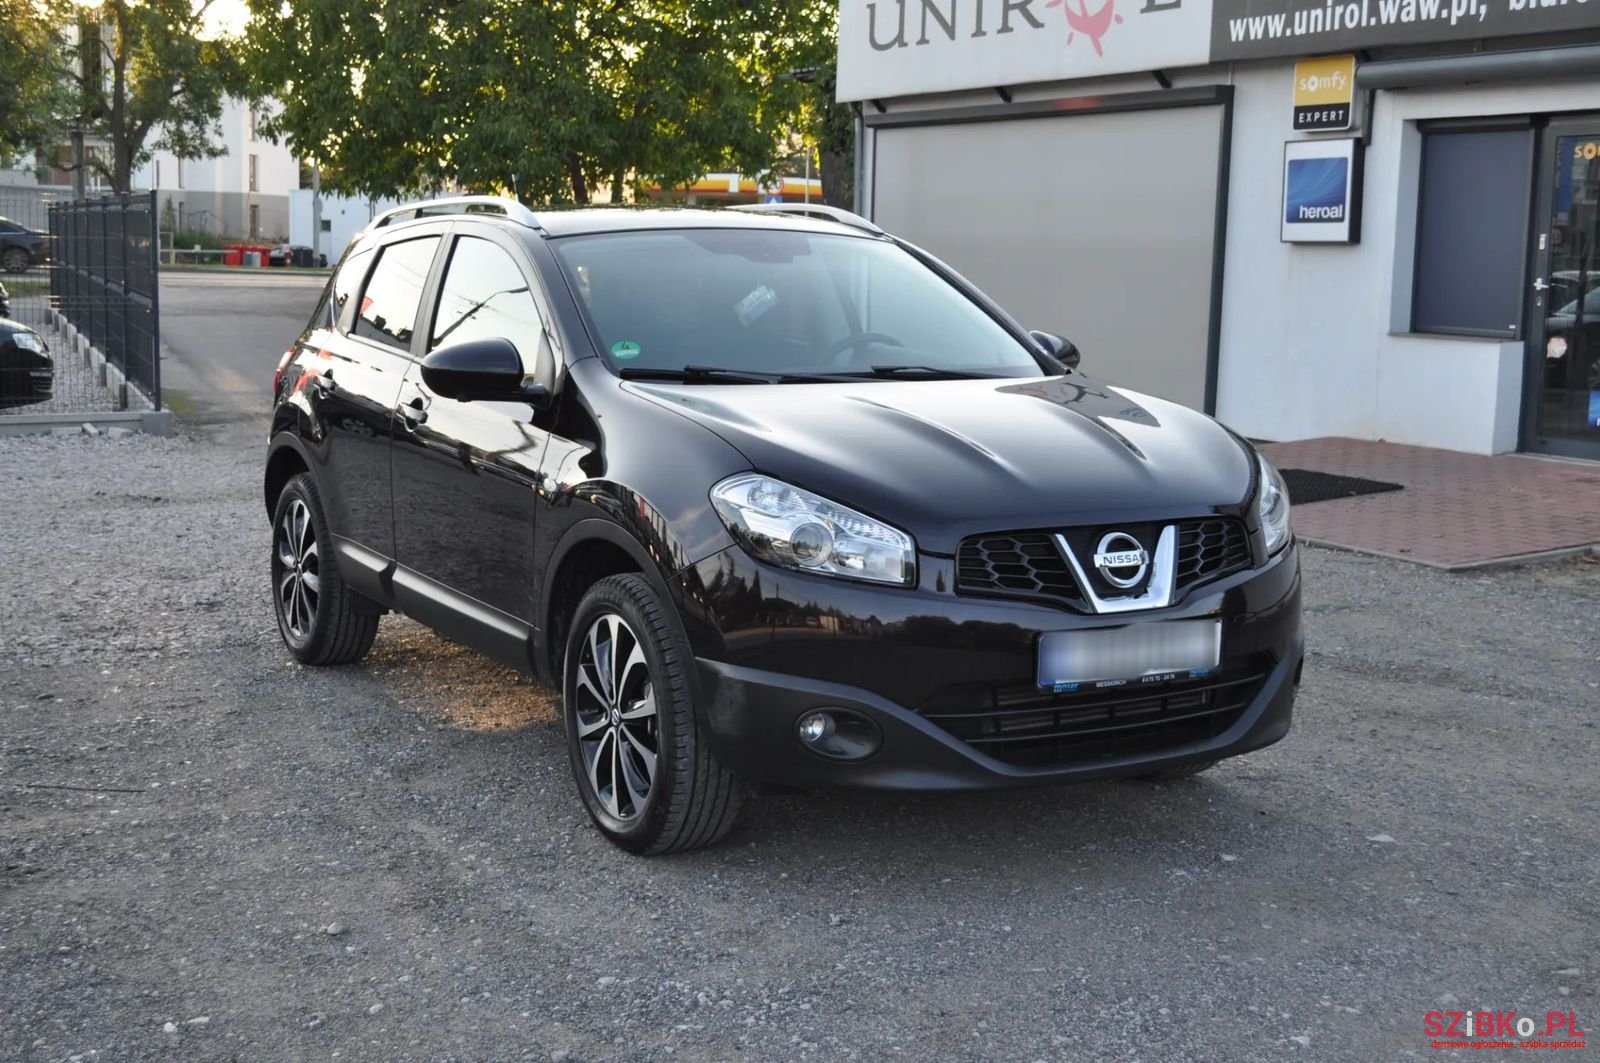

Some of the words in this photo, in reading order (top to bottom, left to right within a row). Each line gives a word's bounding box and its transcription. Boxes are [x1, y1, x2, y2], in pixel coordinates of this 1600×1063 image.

[1300, 71, 1347, 92] somfy
[1298, 110, 1345, 123] EXPERT
[1573, 143, 1600, 159] so
[1299, 204, 1344, 219] heroal
